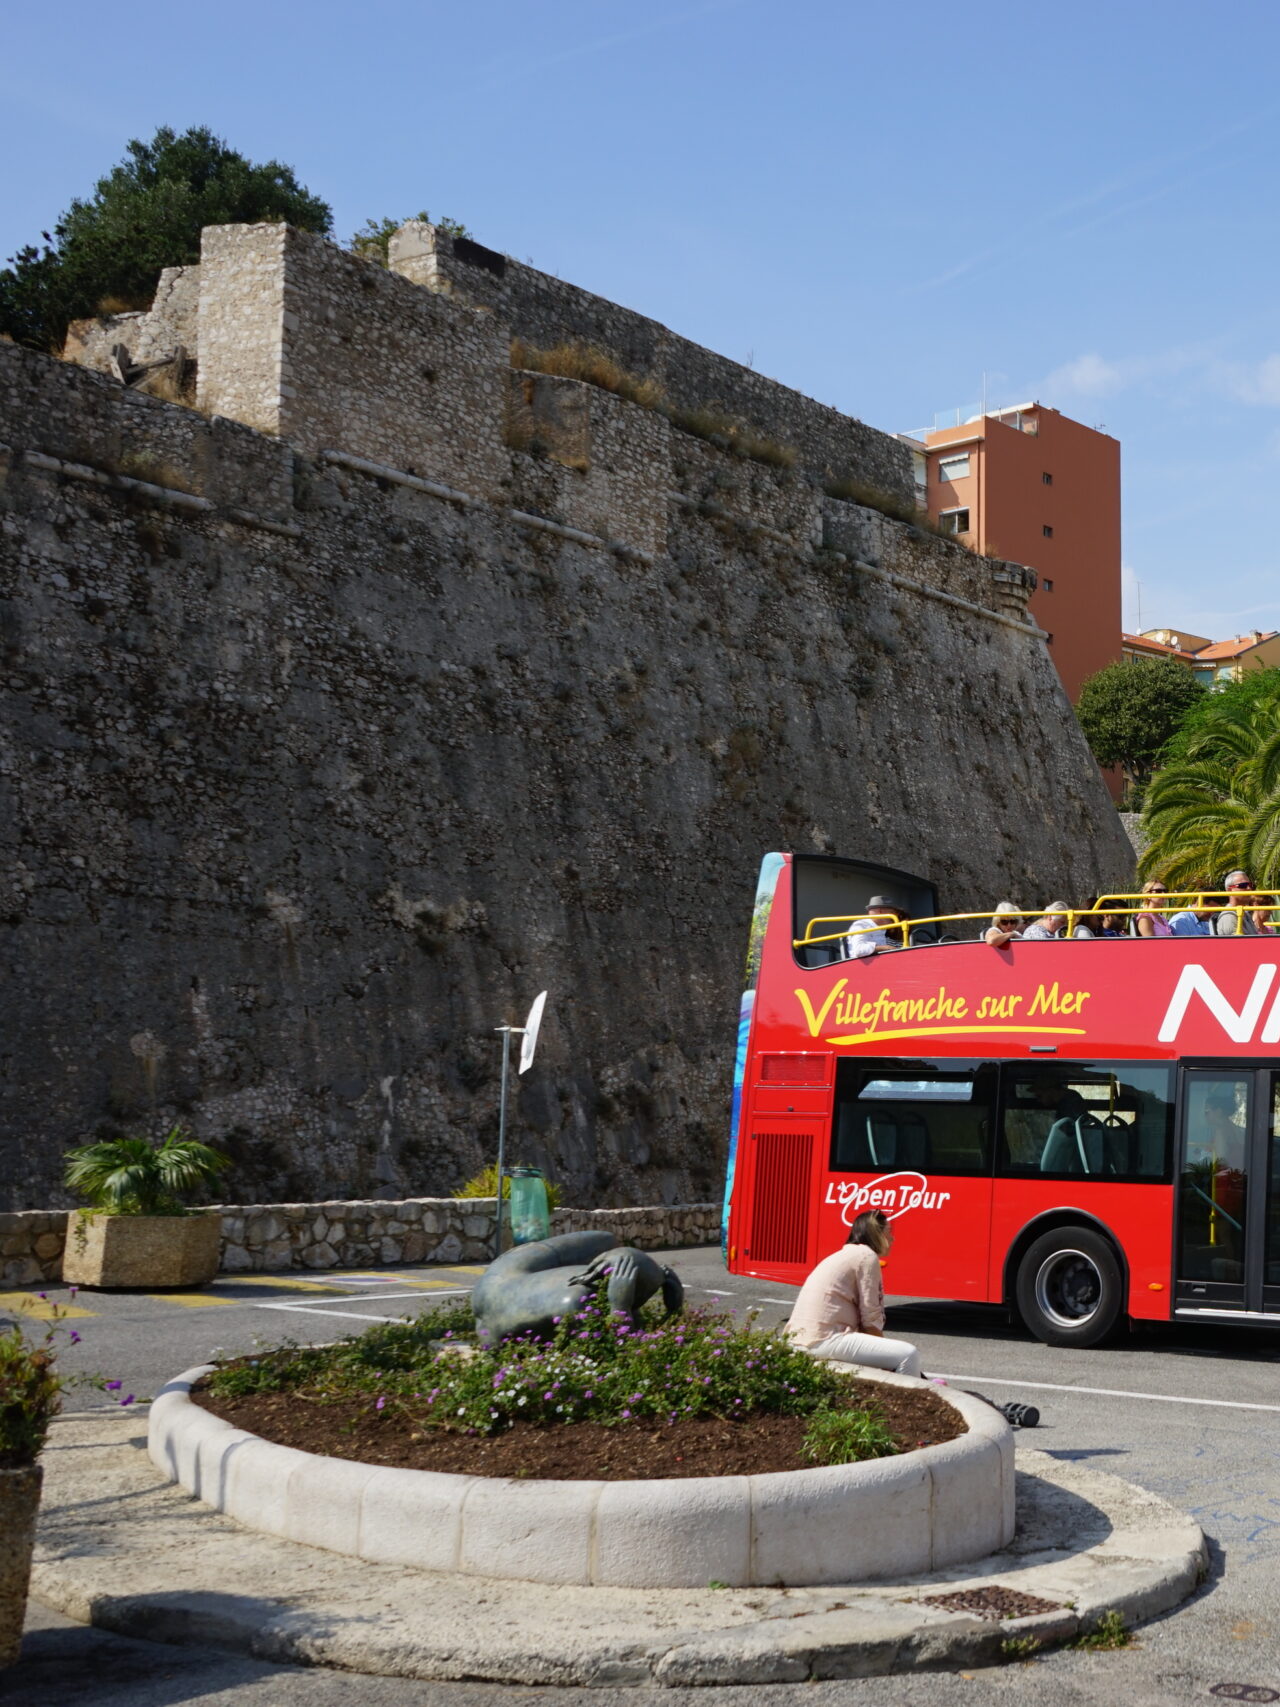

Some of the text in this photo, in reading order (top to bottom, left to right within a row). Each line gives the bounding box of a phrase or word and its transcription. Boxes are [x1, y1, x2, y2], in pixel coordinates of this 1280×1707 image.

[794, 978, 1091, 1037] Villefranche sur Mer
